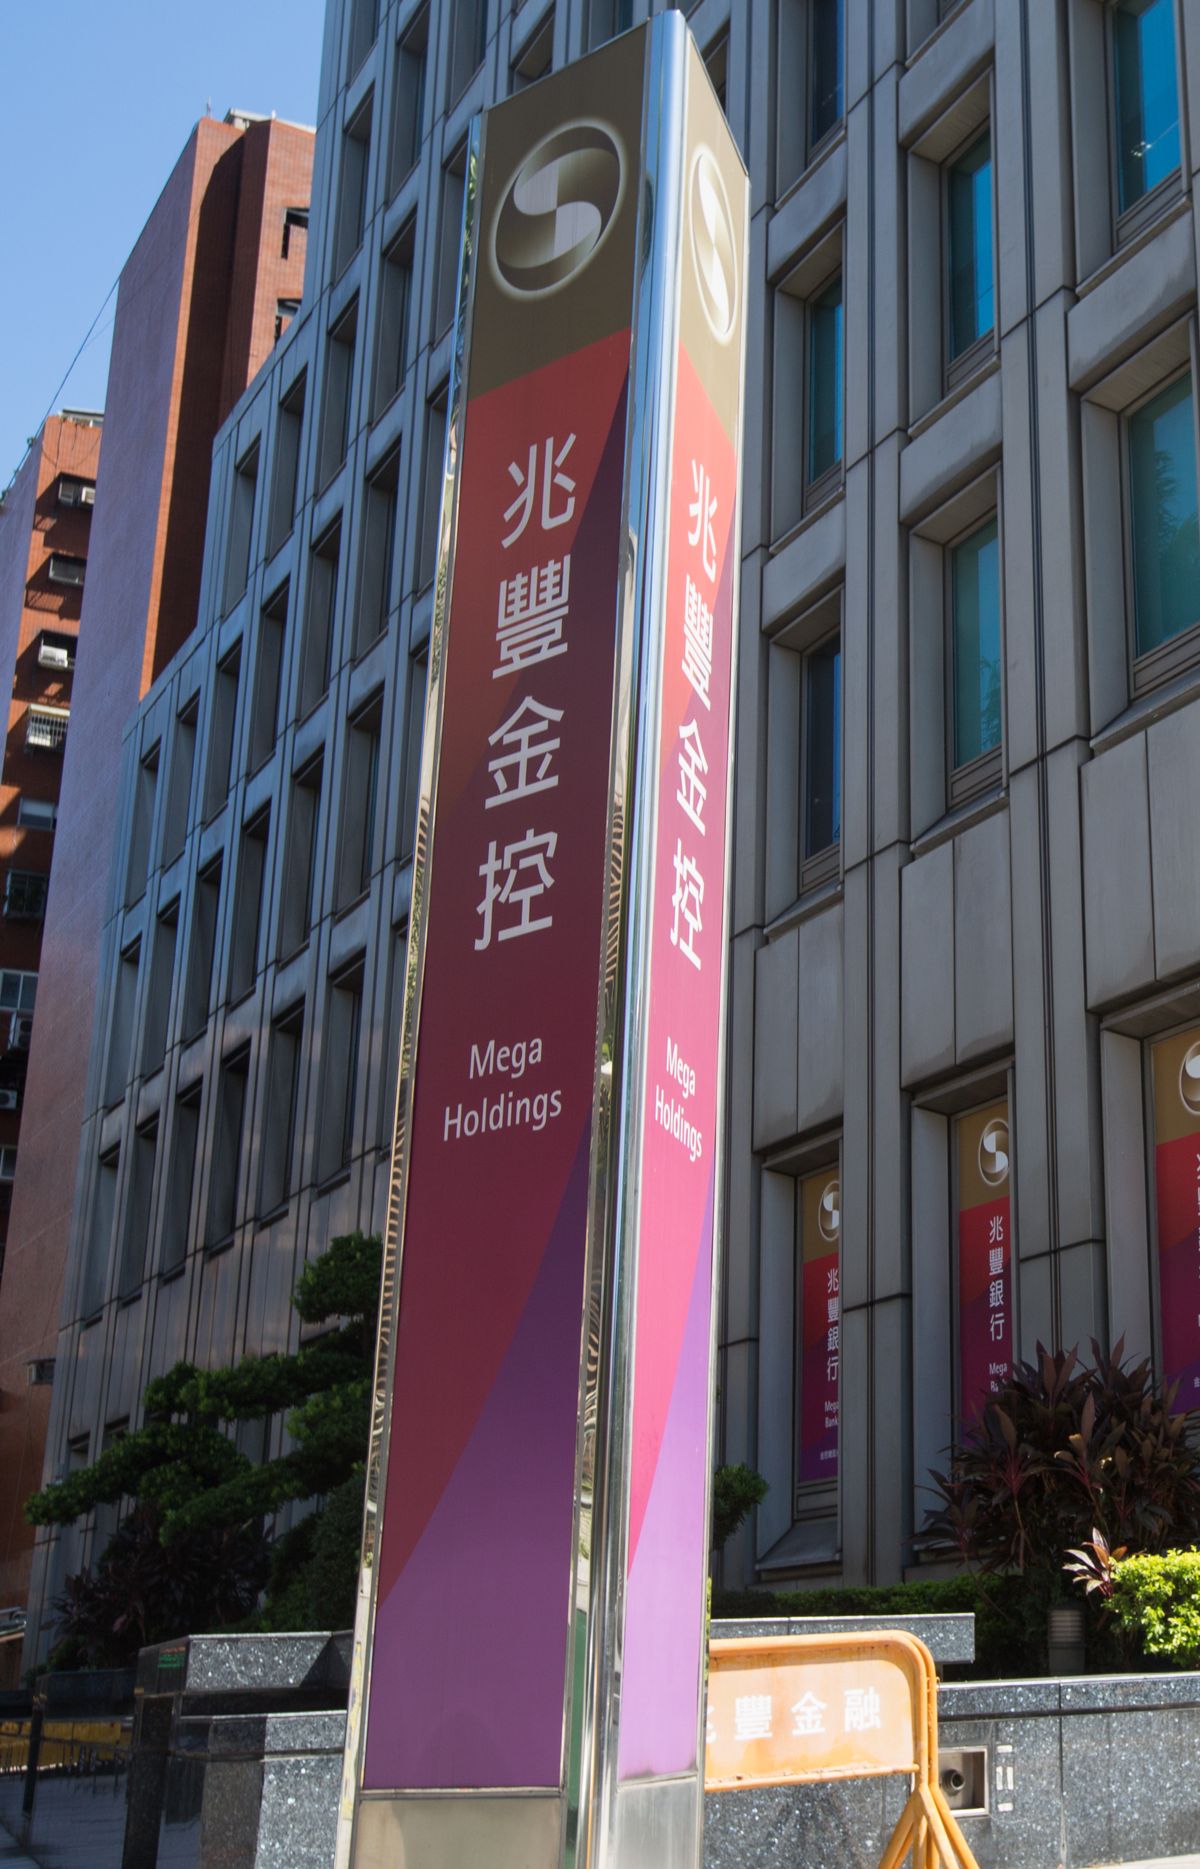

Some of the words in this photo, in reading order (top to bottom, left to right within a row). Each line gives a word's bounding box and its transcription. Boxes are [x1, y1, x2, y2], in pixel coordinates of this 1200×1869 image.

[473, 432, 577, 952] 兆豐金控
[669, 458, 717, 971] 兆豐金控
[468, 1036, 544, 1081] Mega
[664, 1036, 697, 1098] Mega
[443, 1089, 563, 1143] Holdings
[654, 1085, 704, 1163] Holdings
[988, 1215, 1005, 1342] 兆豐銀行
[988, 1361, 1008, 1377] Mega
